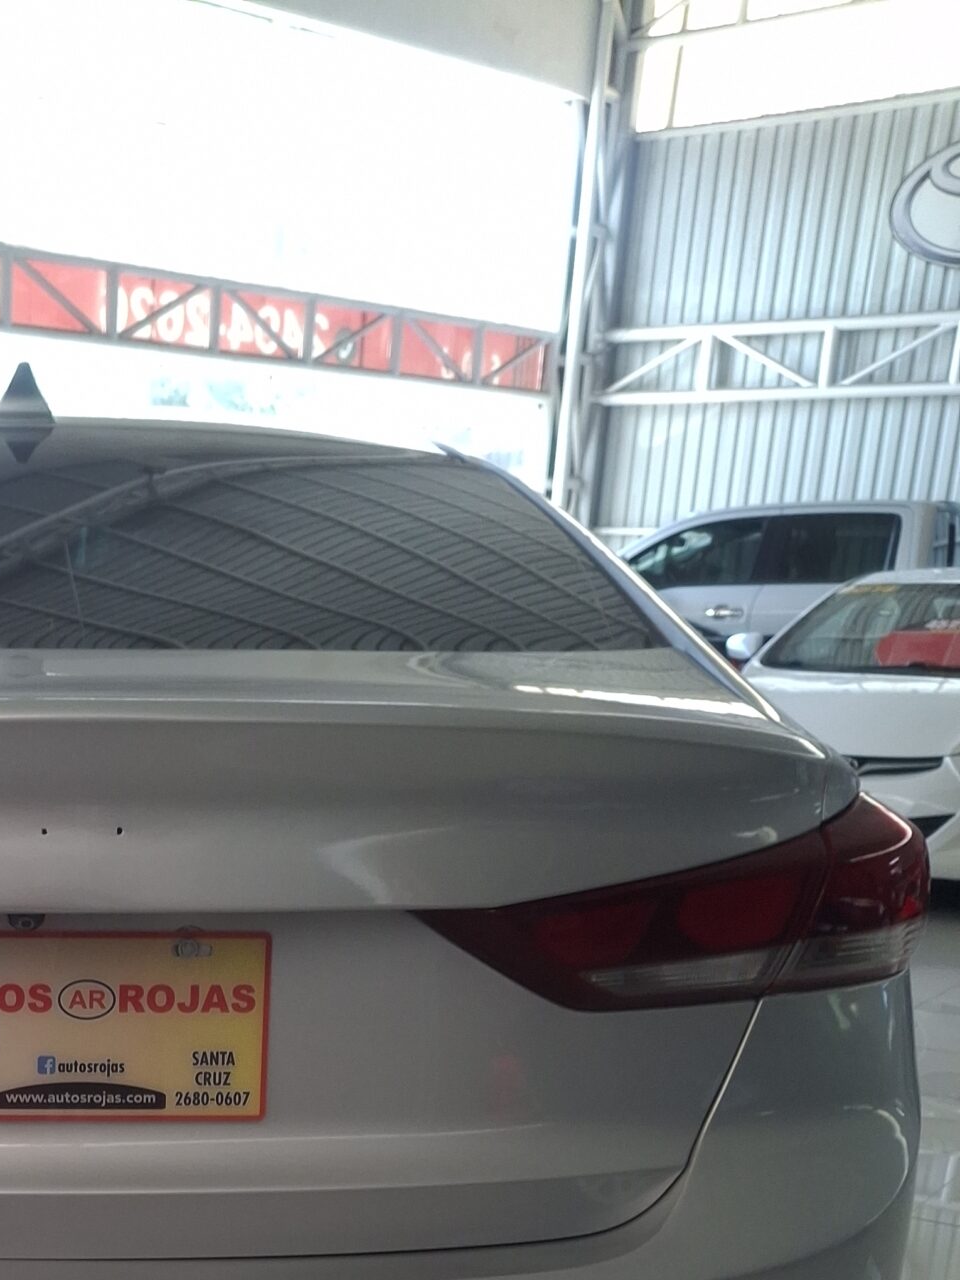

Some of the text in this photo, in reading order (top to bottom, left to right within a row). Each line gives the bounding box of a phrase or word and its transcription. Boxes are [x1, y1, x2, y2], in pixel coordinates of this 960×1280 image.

[67, 989, 106, 1010] AR
[118, 983, 256, 1014] ROJAS
[191, 1050, 236, 1067] SANTA
[57, 1058, 126, 1078] autosrojas
[195, 1070, 232, 1087] CRUZ
[5, 1090, 156, 1107] www.autosrojas.com
[174, 1091, 251, 1107] 2680-0607
